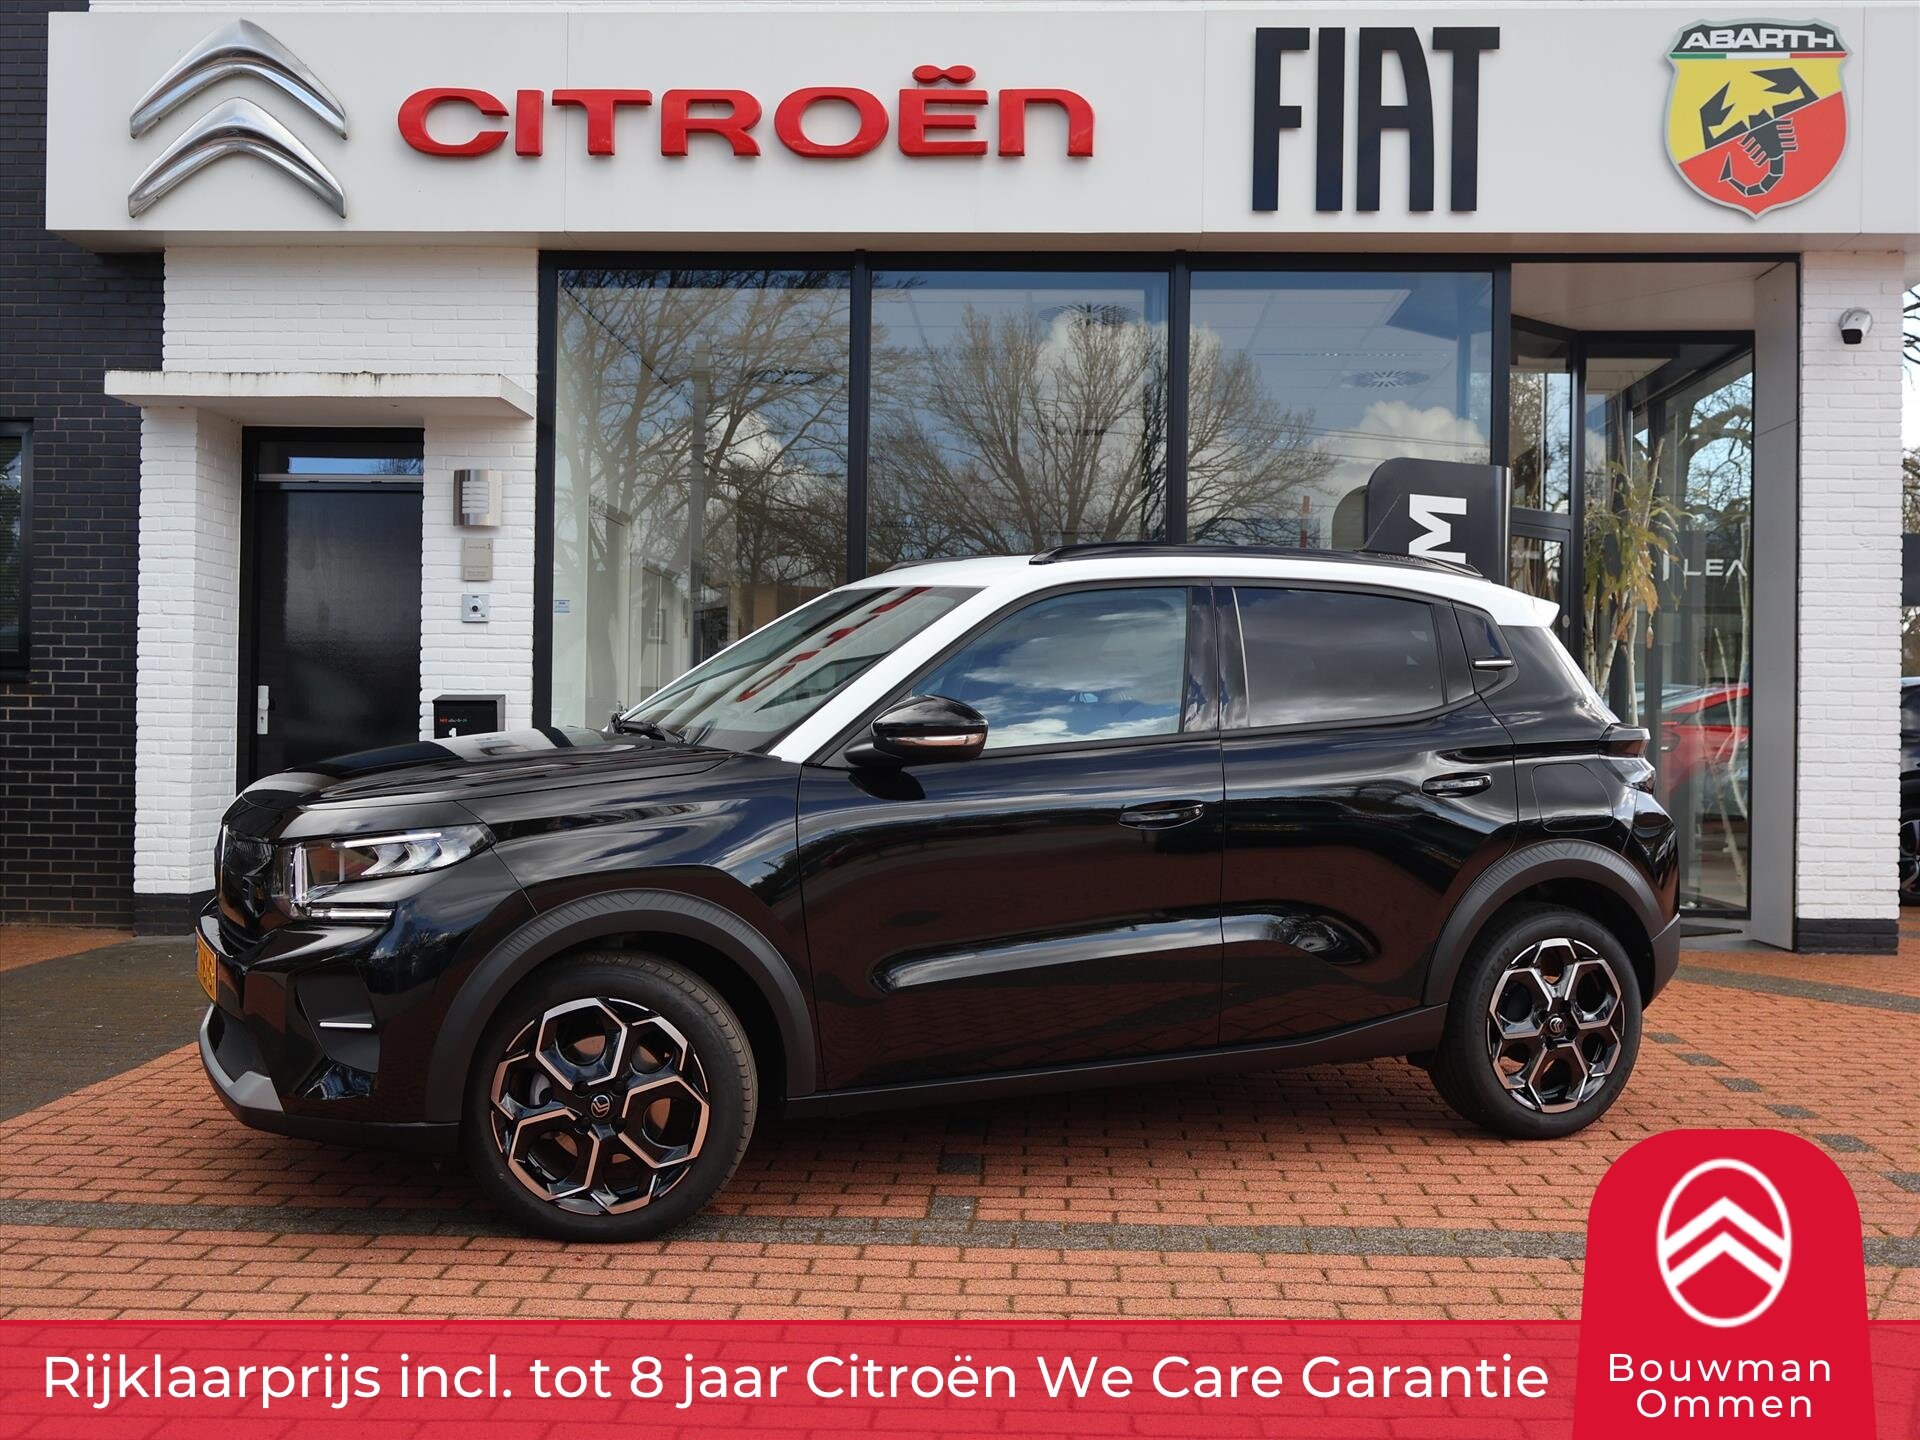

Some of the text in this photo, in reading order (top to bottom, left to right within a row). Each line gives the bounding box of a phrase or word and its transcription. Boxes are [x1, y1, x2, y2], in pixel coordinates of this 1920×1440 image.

[1682, 28, 1834, 49] ABARTH
[398, 65, 1094, 158] CITROËN
[1252, 26, 1500, 213] FIAT
